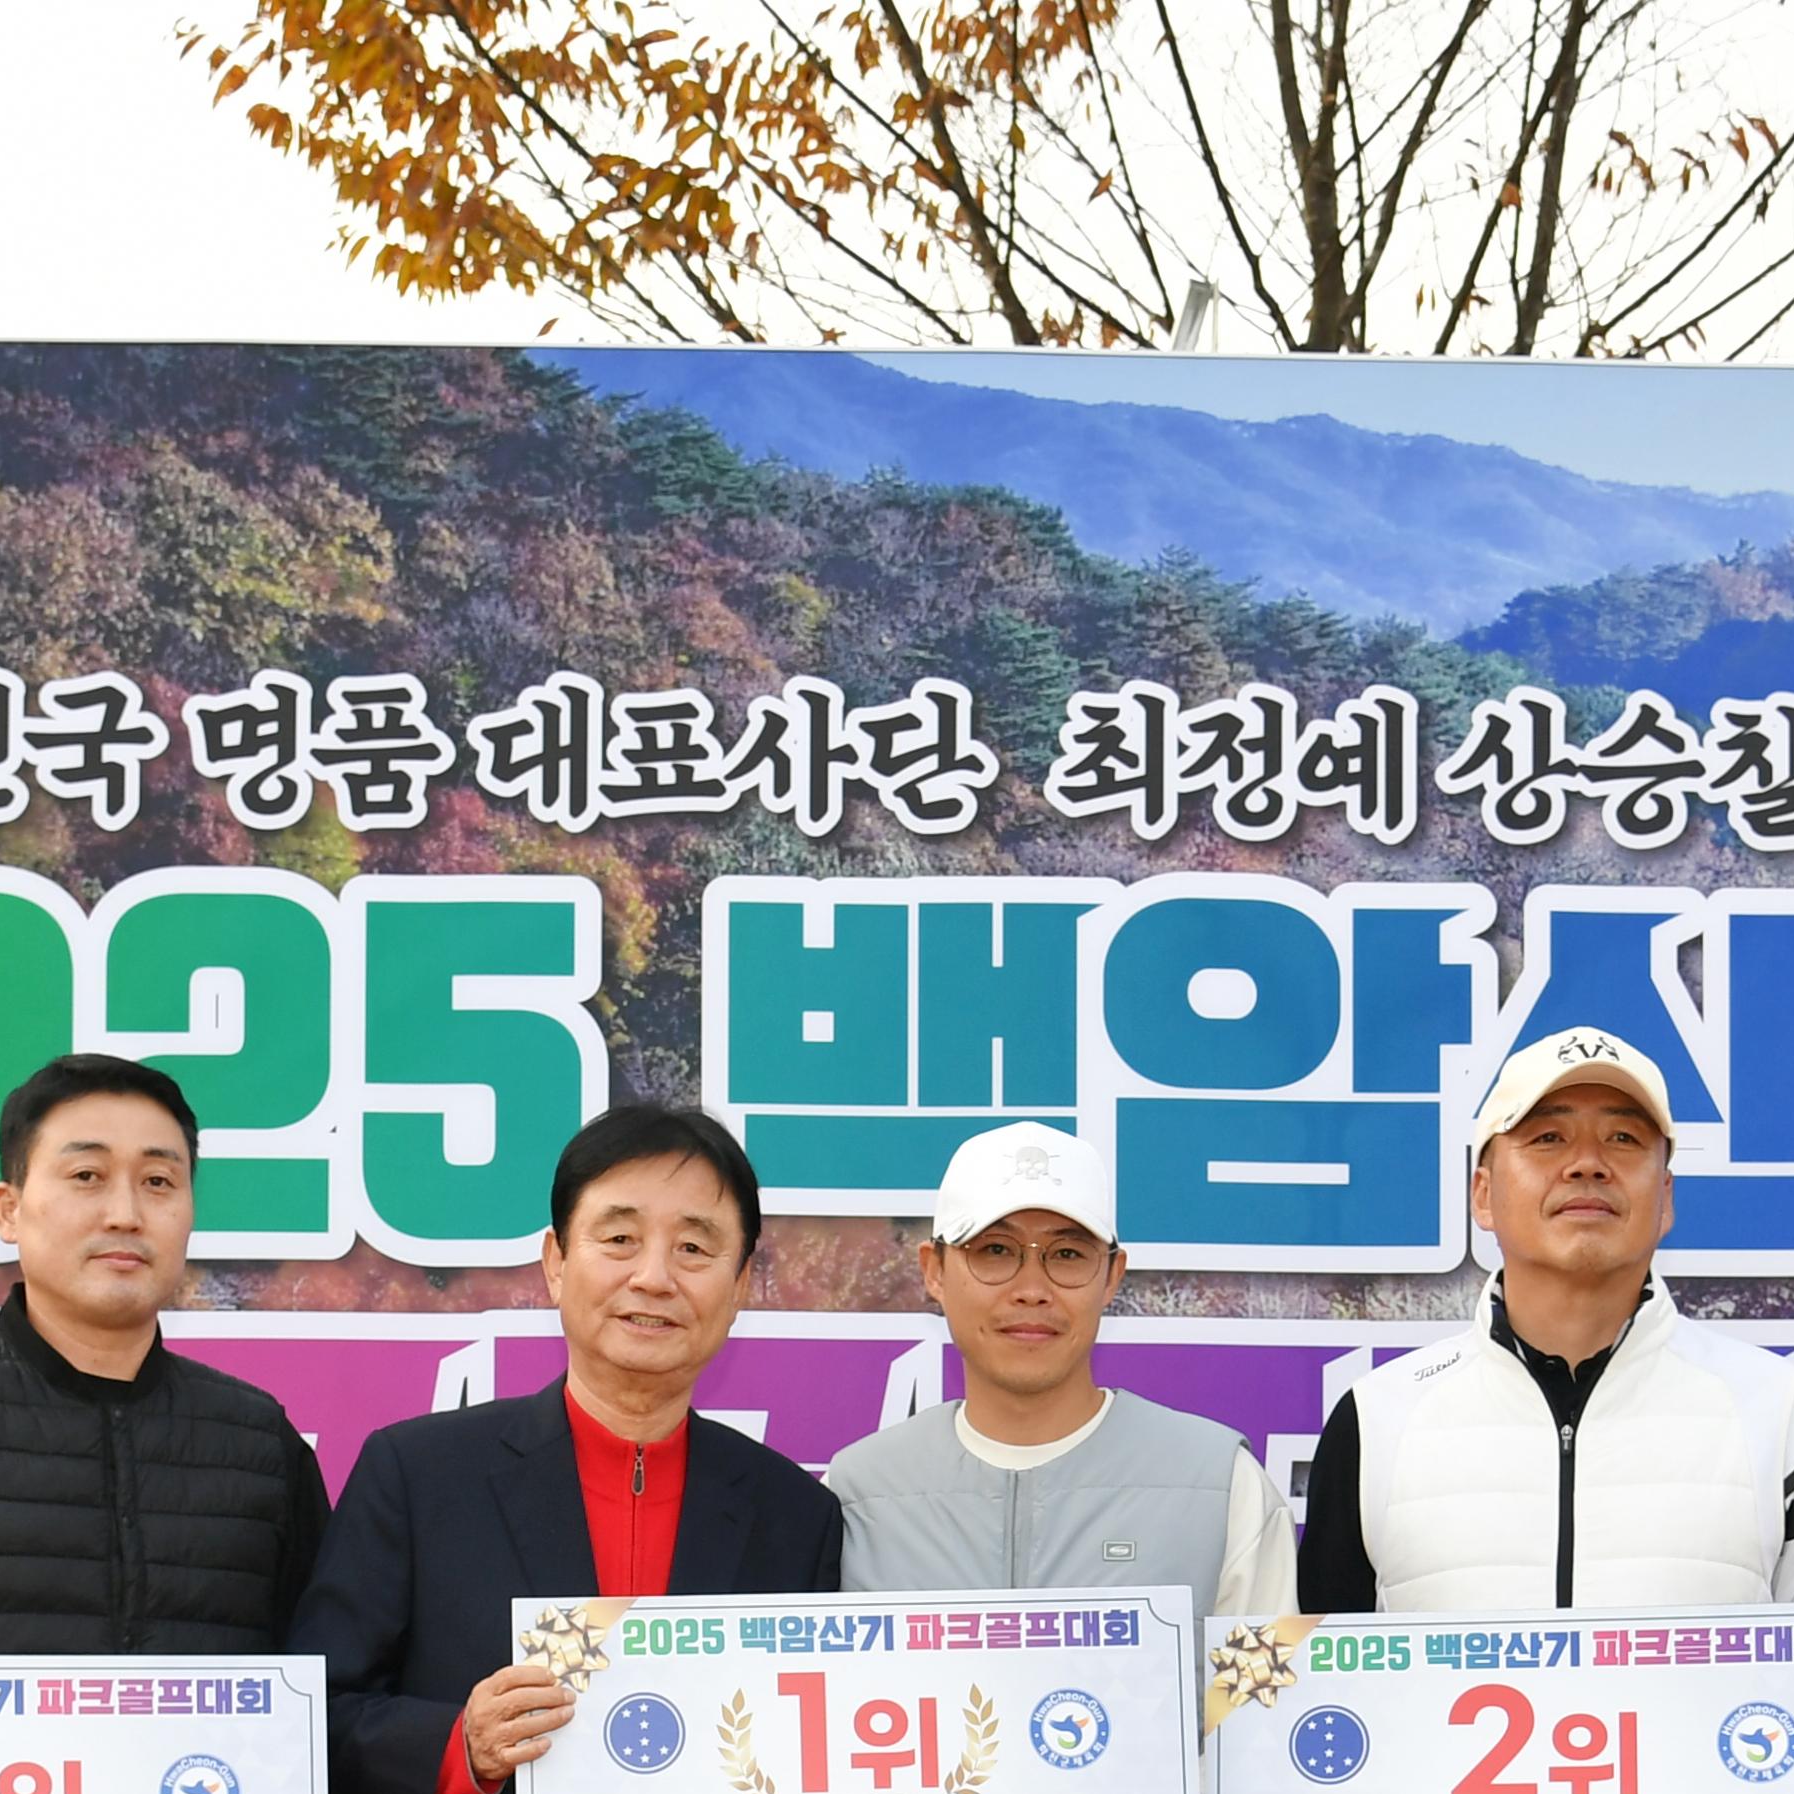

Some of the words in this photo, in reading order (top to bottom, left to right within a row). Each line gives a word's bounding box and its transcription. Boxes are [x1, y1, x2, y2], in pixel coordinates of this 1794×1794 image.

[197, 683, 441, 815] 명품
[481, 686, 986, 823] 대표사단
[1058, 693, 1404, 830] 최정예
[623, 1617, 725, 1656] 2025
[739, 1614, 895, 1654] 백암산기
[906, 1609, 1141, 1651] 파크골프대회
[1310, 1634, 1411, 1673] 2025
[1424, 1631, 1581, 1670] 백암산기
[37, 1678, 273, 1716] 파크골프대회
[777, 1671, 939, 1794] 1위
